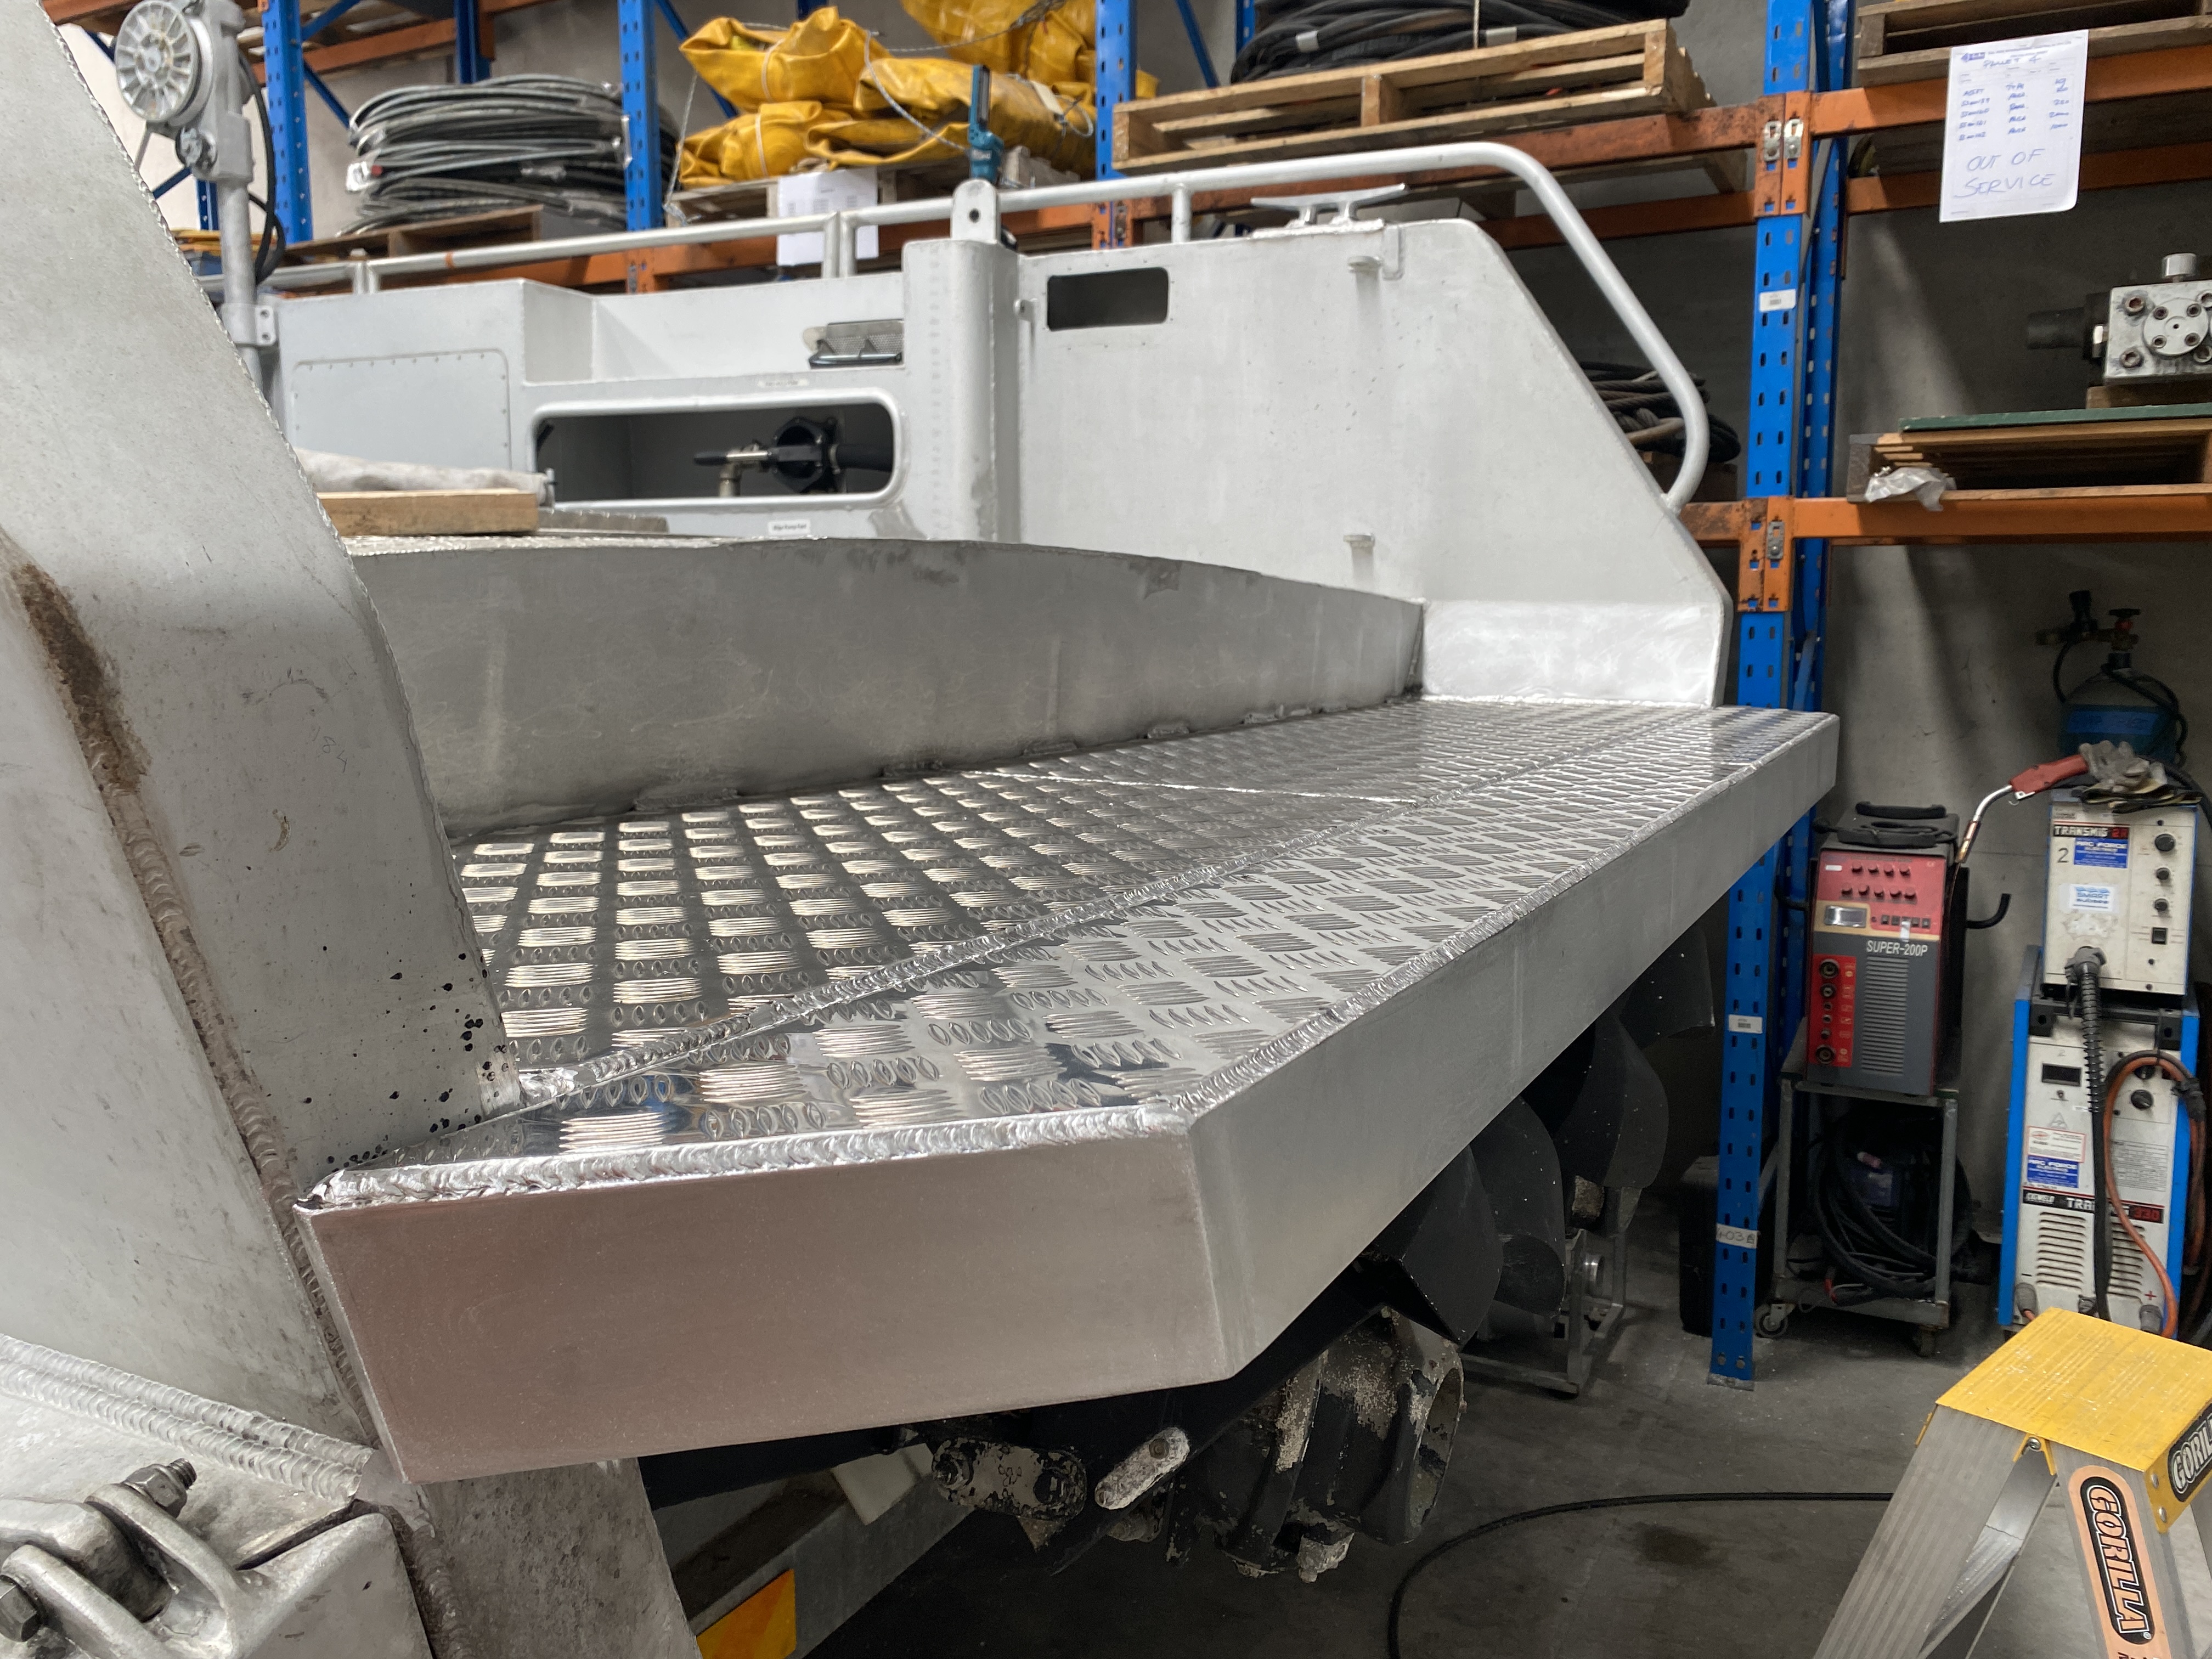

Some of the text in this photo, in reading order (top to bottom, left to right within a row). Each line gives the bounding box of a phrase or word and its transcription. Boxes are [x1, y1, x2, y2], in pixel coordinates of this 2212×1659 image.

[1968, 149, 2045, 171] OUT OF
[1955, 174, 2056, 198] SERVICE
[2055, 826, 2108, 837] TRANSMIG
[2057, 848, 2069, 864] 2
[1867, 940, 1928, 957] SUPER-200P
[2171, 1413, 2212, 1494] GORIL
[2087, 1485, 2149, 1633] GORILLA
